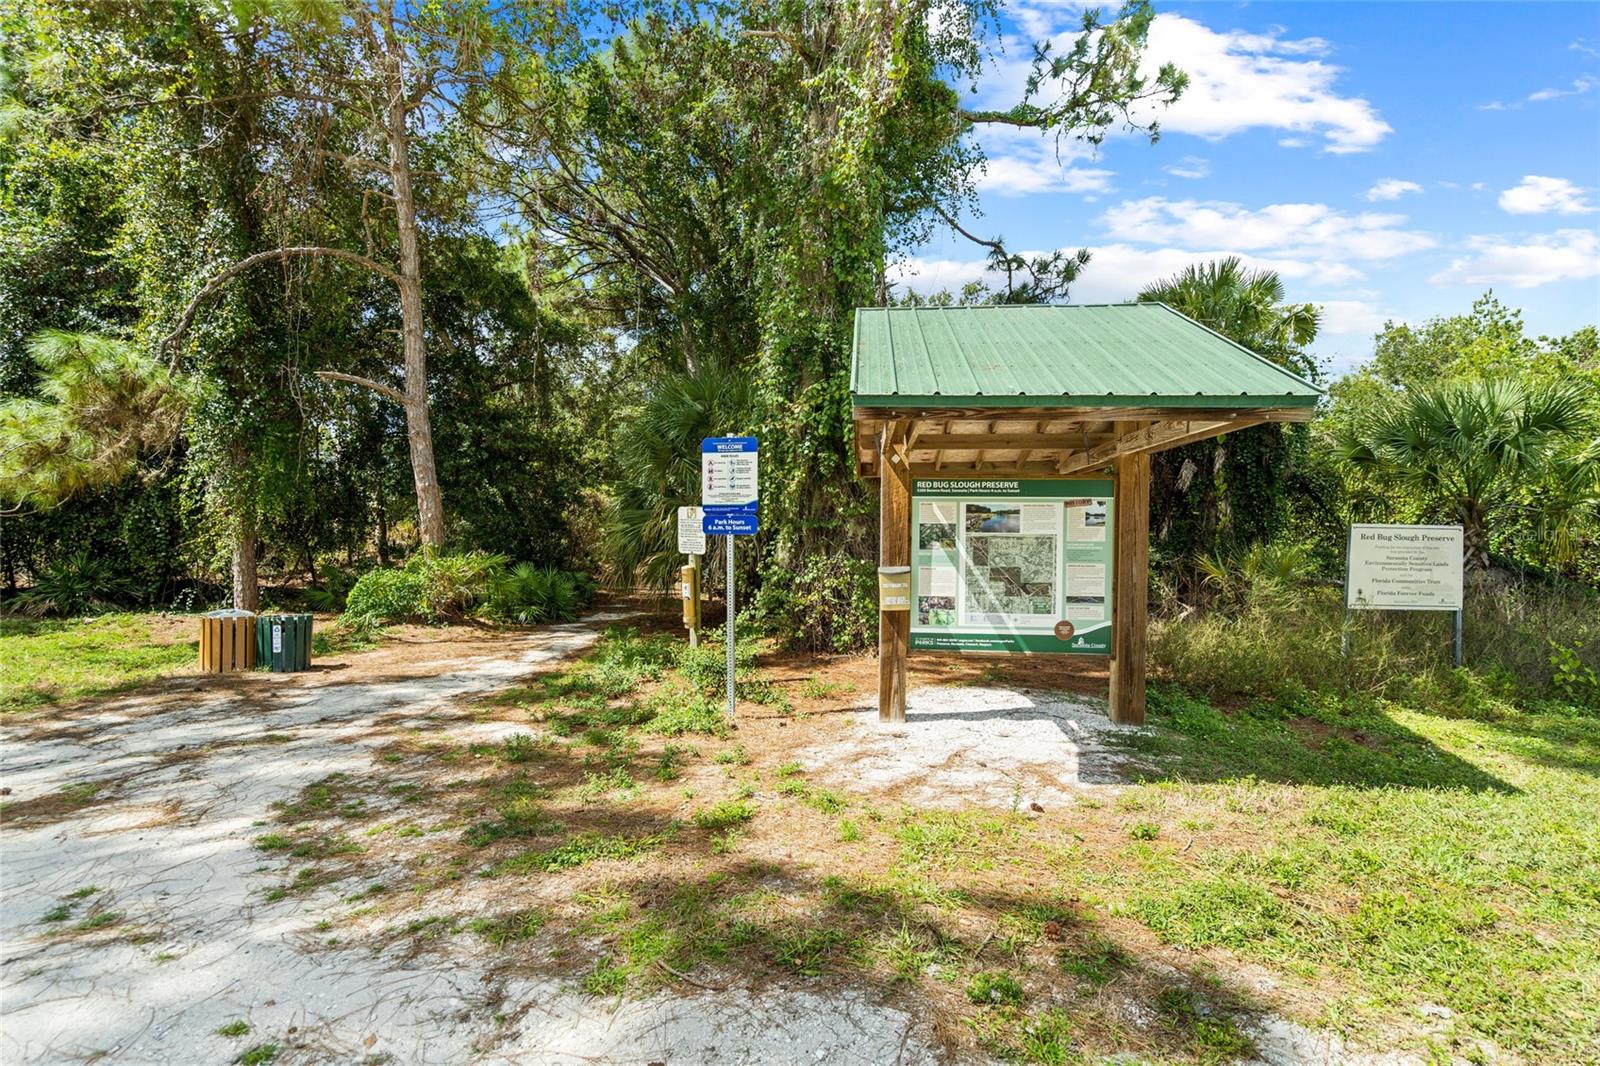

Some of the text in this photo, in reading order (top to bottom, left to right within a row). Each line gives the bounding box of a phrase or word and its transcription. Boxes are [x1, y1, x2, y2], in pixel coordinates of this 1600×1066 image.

[950, 481, 980, 489] SLOUGH
[981, 481, 1019, 489] PRESERVE
[1360, 533, 1455, 542] Red Bug Slough Preserve
